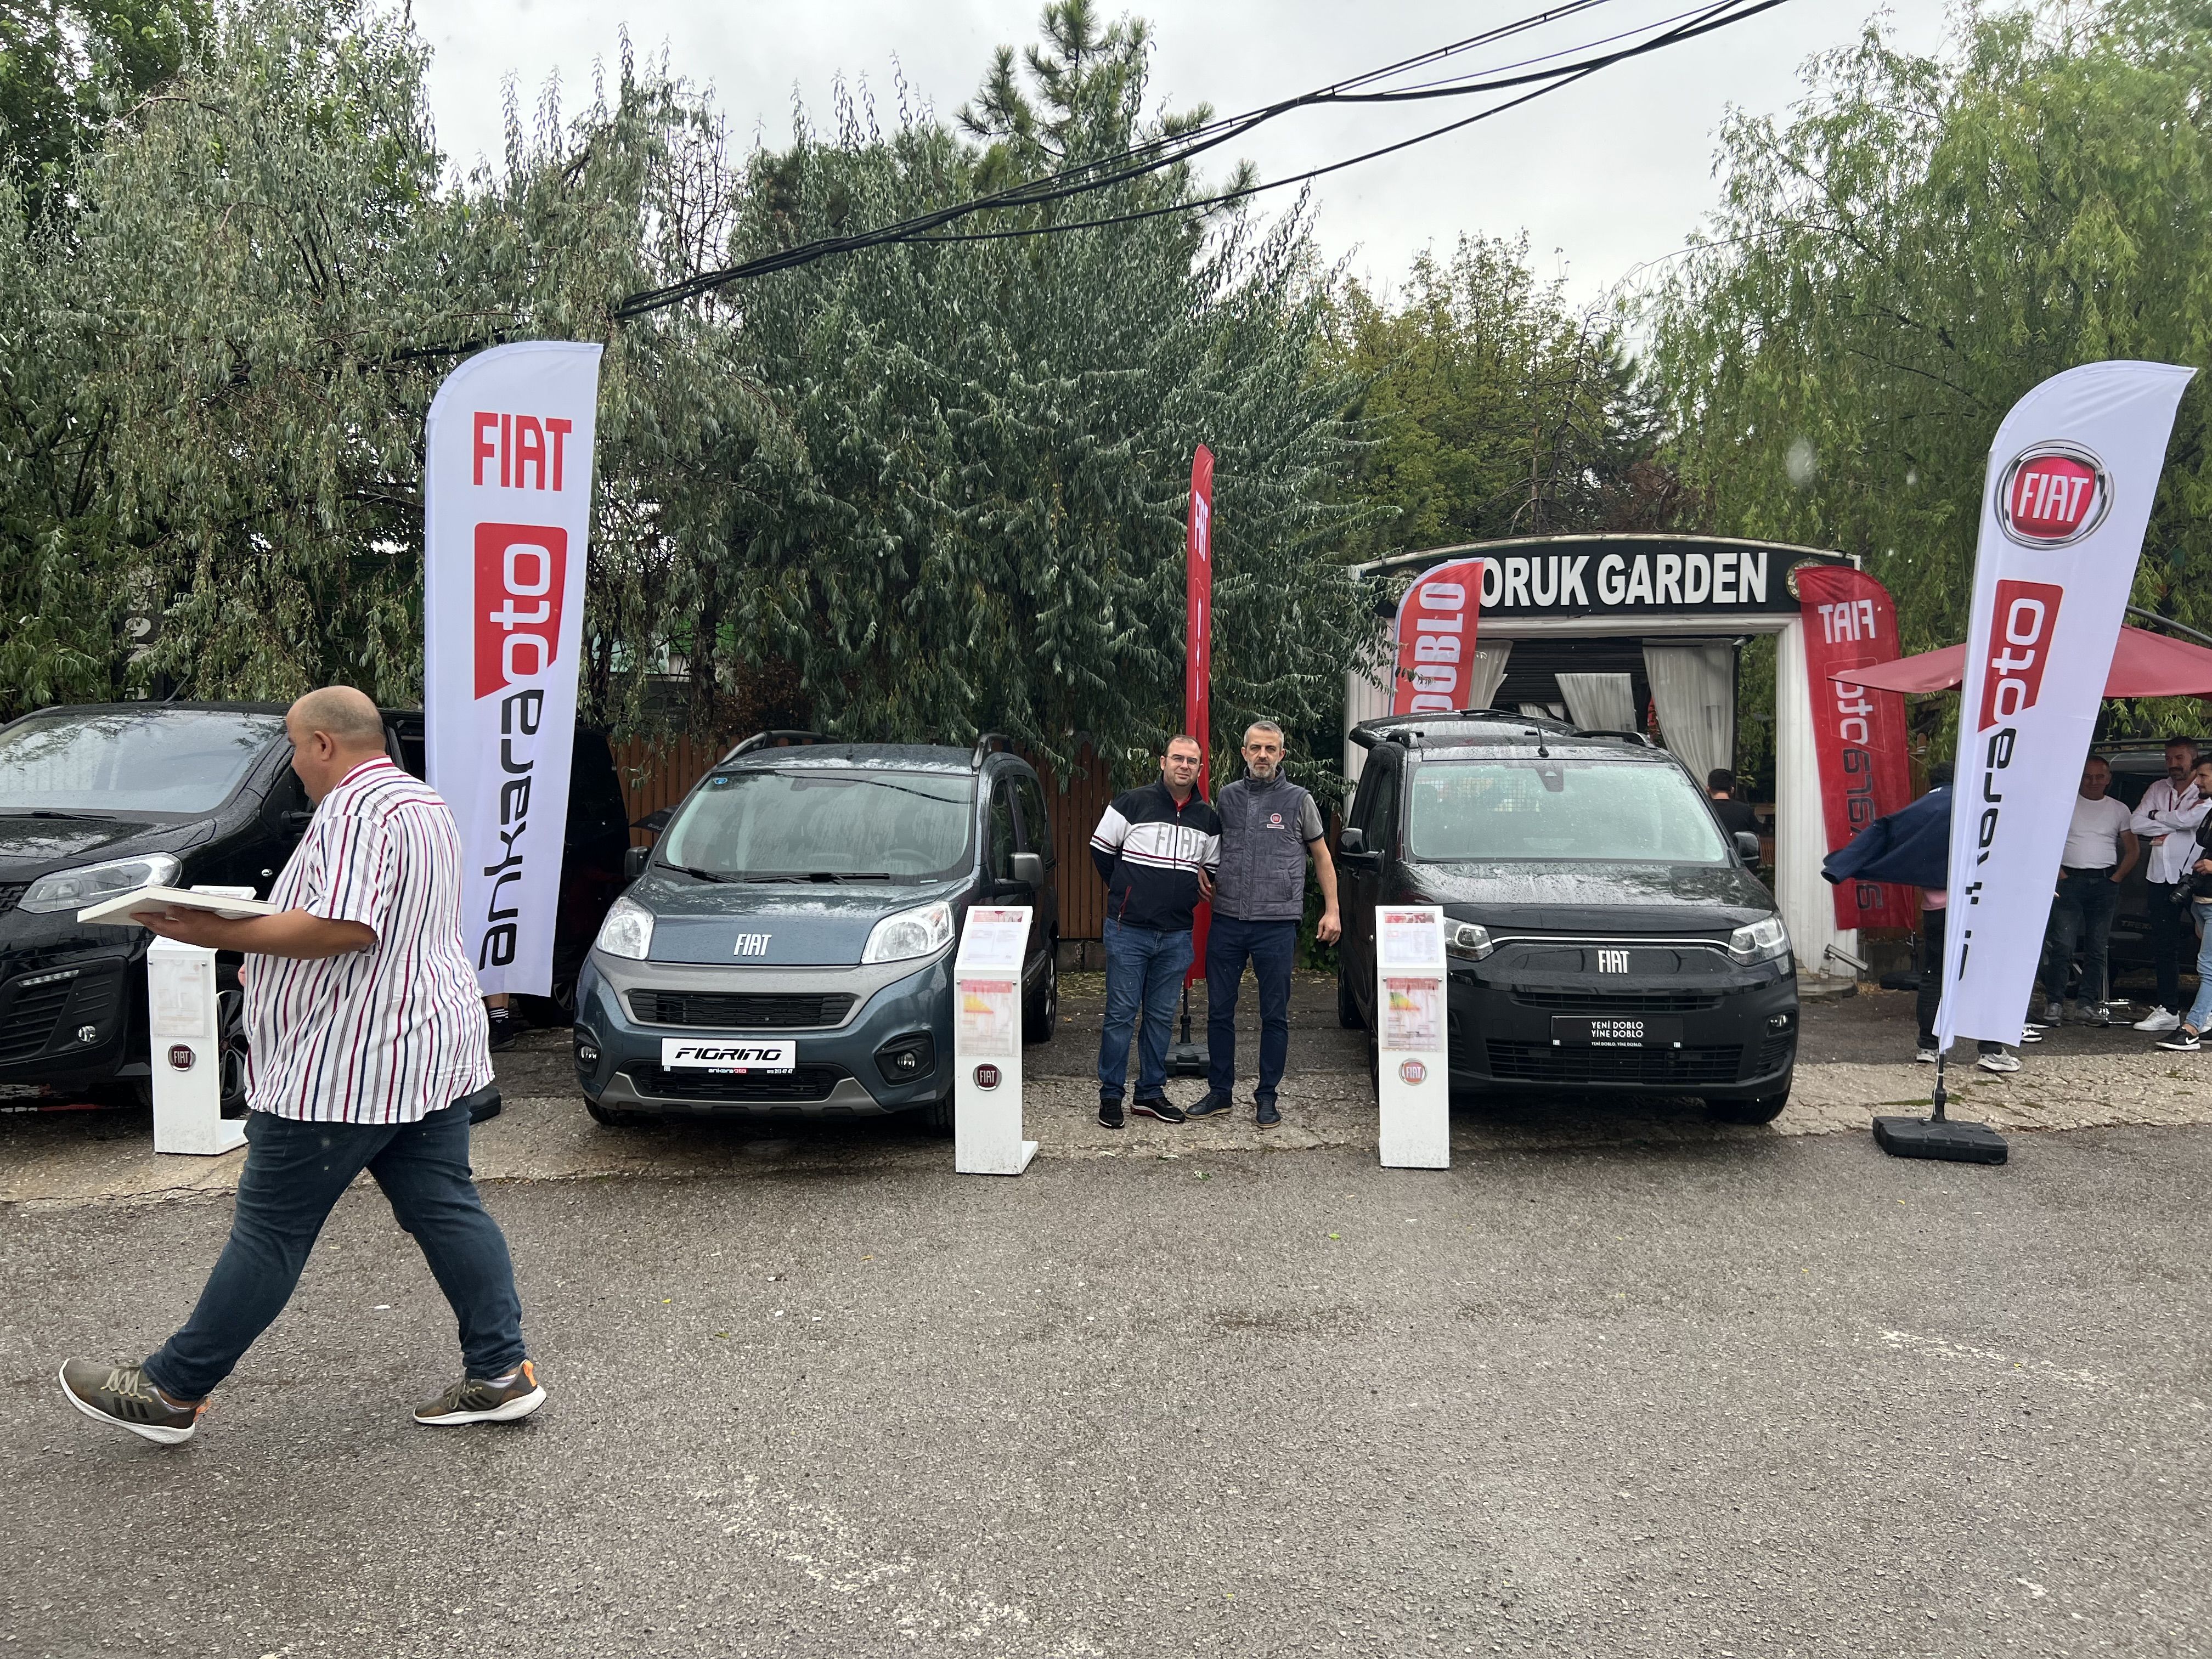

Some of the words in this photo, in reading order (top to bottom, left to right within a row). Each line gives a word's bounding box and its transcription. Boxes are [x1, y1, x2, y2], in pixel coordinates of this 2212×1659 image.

[473, 412, 572, 492] FIAT
[2017, 472, 2090, 522] FIAT
[1448, 556, 1590, 607] ORUK
[1597, 552, 1768, 605] GARDEN
[1154, 823, 1200, 860] FIAT
[733, 934, 772, 956] FIAT
[1598, 950, 1630, 974] FIAT
[174, 1051, 189, 1064] FIAT
[675, 1048, 782, 1060] FIORINO
[980, 1070, 996, 1083] FIAT
[1406, 1066, 1421, 1079] FIAT
